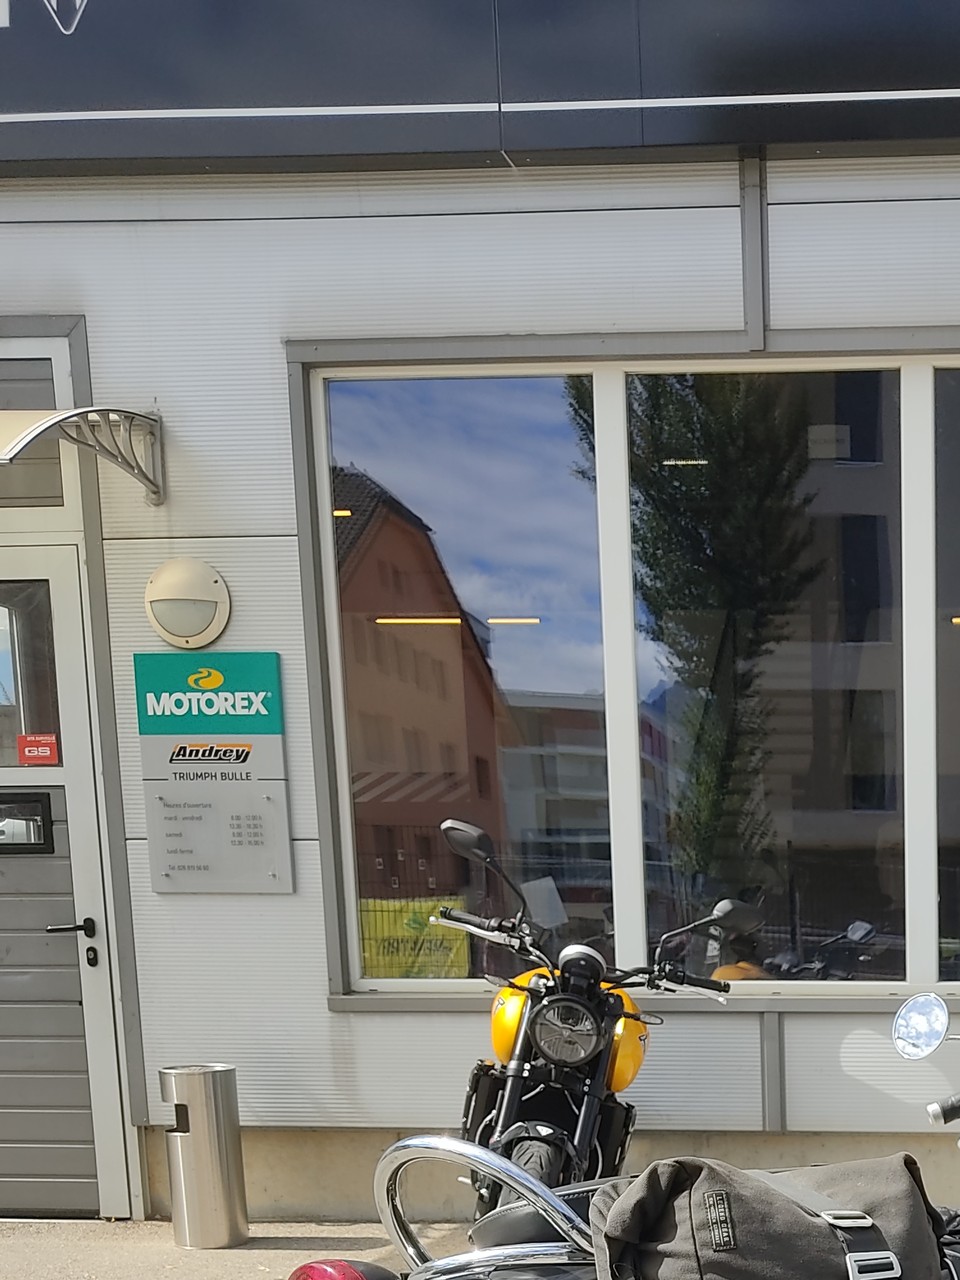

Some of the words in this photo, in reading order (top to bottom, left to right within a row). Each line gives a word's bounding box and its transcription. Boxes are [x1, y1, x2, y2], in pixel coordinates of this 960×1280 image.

[146, 691, 269, 716] MOTOREX
[25, 747, 50, 756] GS
[175, 745, 246, 763] Andrey
[172, 771, 218, 781] TRIUMPH
[220, 771, 252, 781] BULLE
[716, 1196, 726, 1221] LEGEND
[721, 1223, 730, 1242] GEAR
